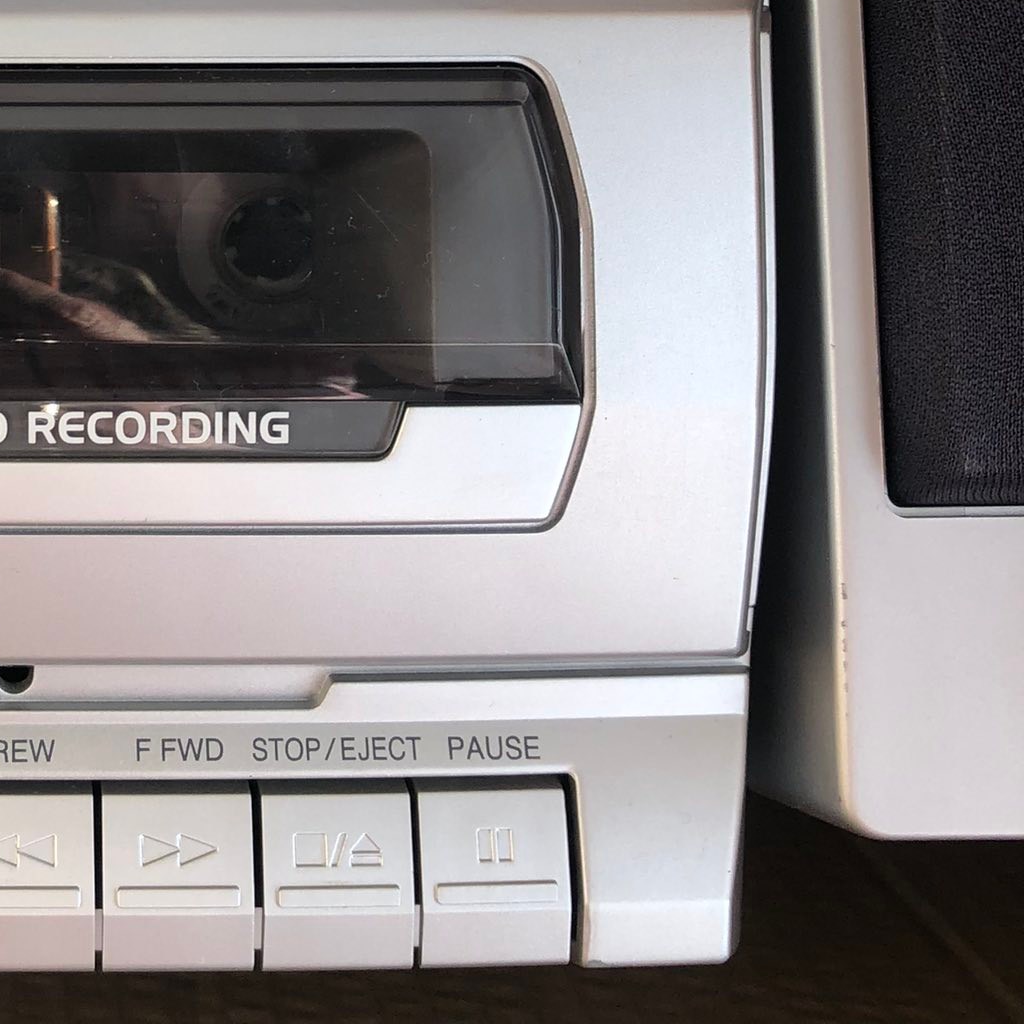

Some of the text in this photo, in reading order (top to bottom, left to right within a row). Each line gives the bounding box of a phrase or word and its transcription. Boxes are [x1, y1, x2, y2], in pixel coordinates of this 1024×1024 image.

[28, 409, 290, 445] RECORDING
[252, 736, 422, 762] STOP/EJECT
[447, 735, 541, 761] PAUSE
